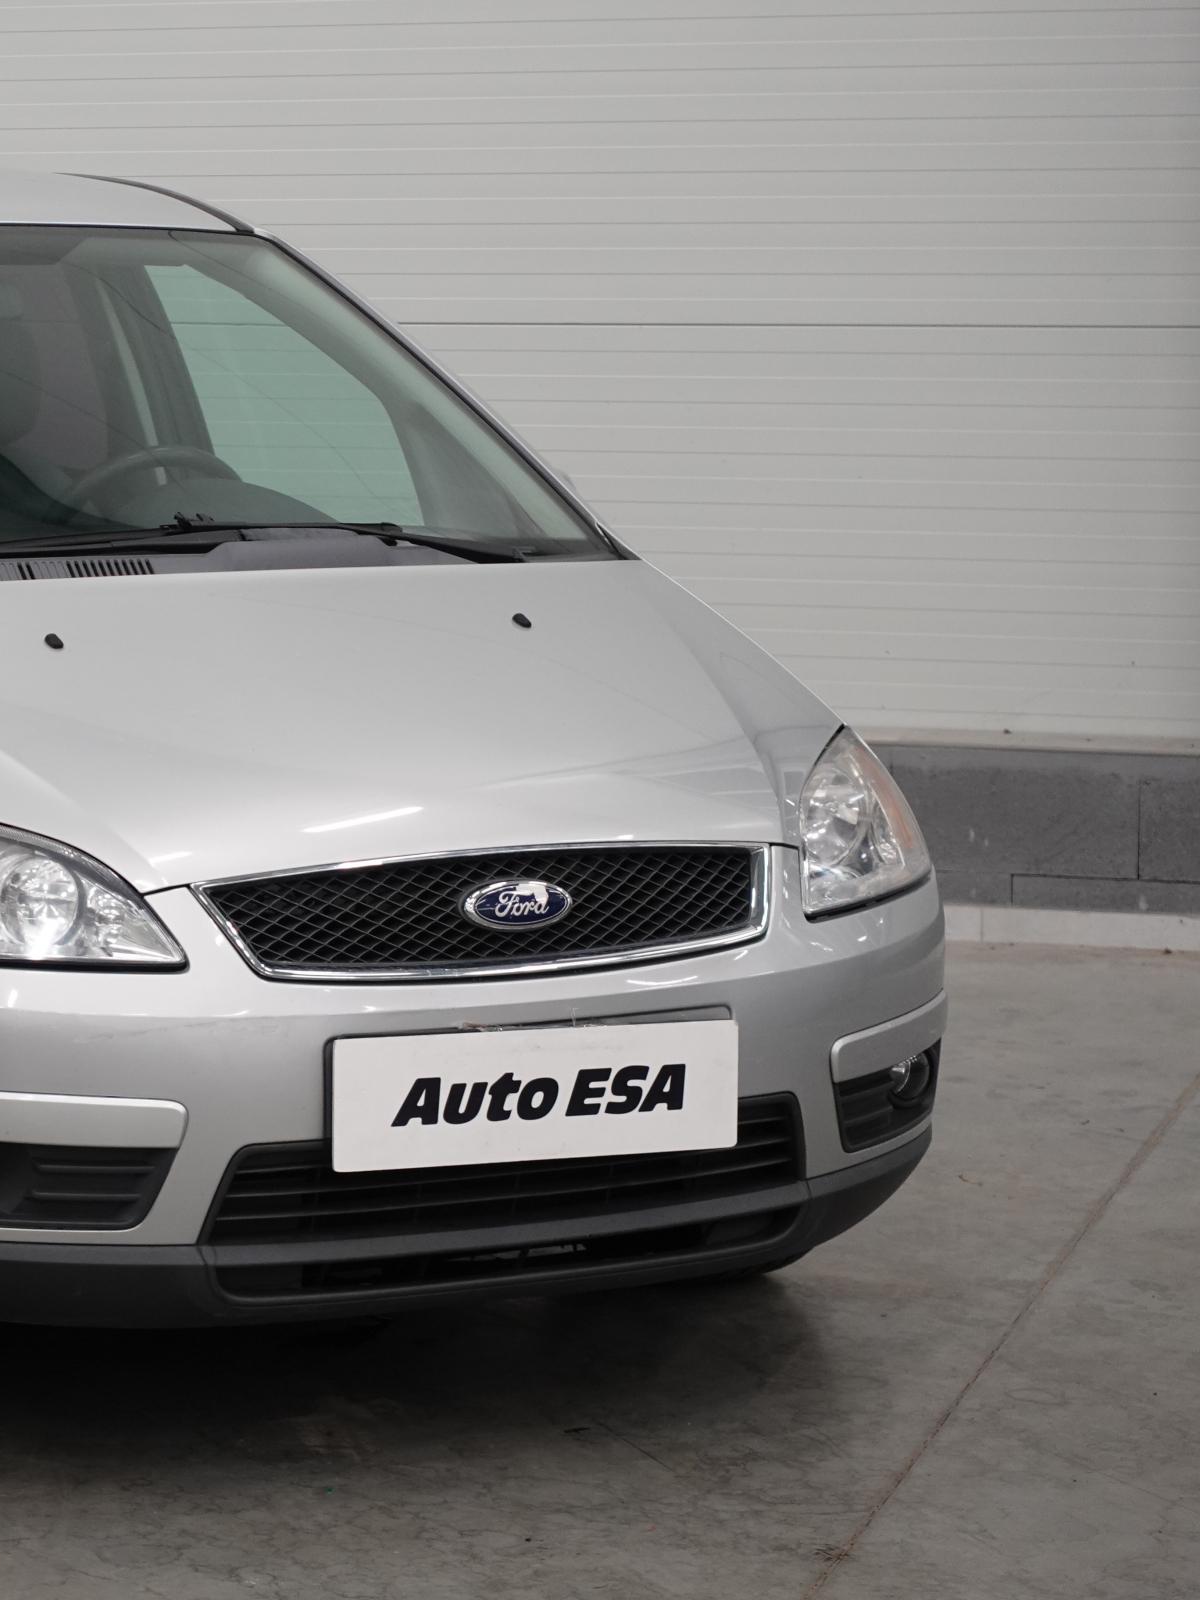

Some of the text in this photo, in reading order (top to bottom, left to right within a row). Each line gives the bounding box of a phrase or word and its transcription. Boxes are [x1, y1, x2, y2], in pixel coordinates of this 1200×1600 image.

[495, 888, 549, 917] Ford
[391, 1063, 686, 1127] Auto ESA
